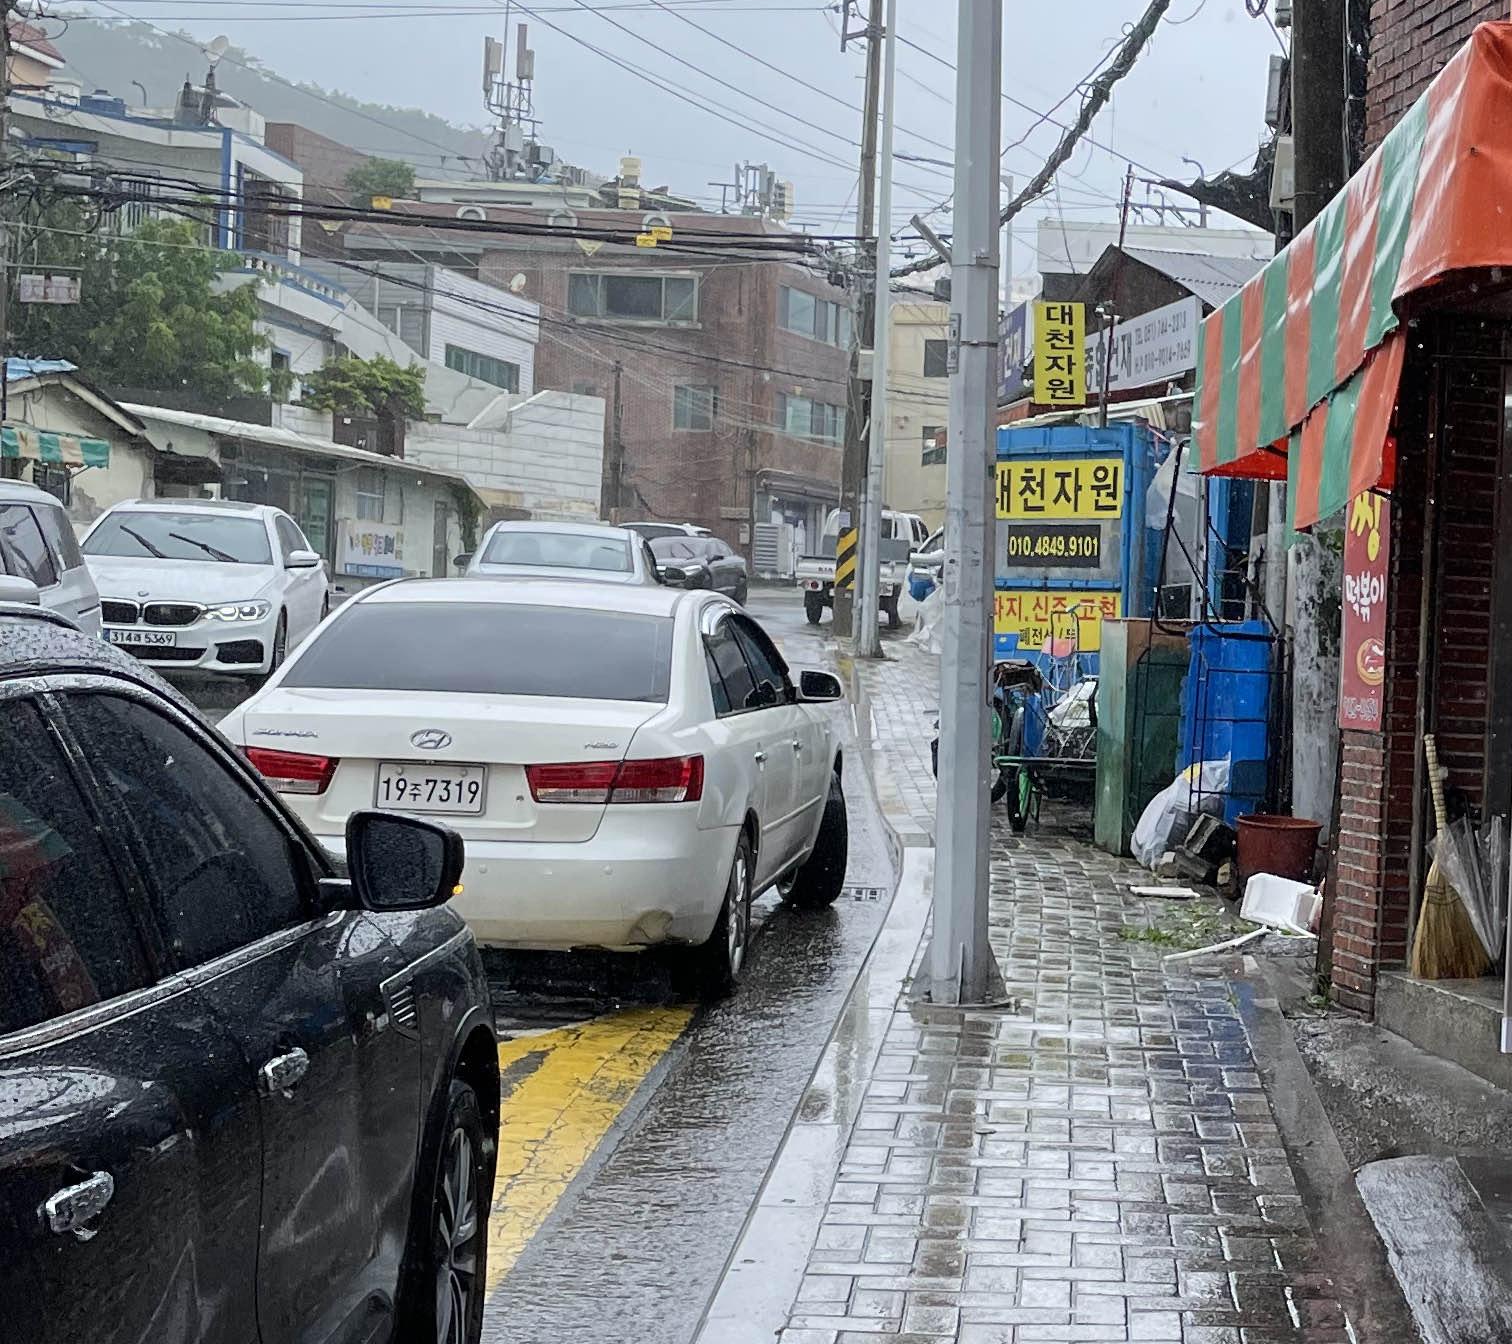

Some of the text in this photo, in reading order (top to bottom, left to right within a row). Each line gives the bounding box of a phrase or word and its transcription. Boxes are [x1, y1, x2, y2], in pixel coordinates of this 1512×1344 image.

[1046, 305, 1076, 399] 대천자원
[1009, 536, 1098, 556] 010.4849.9101
[1346, 570, 1383, 622] 떡볶이
[382, 778, 481, 804] 19주7319
